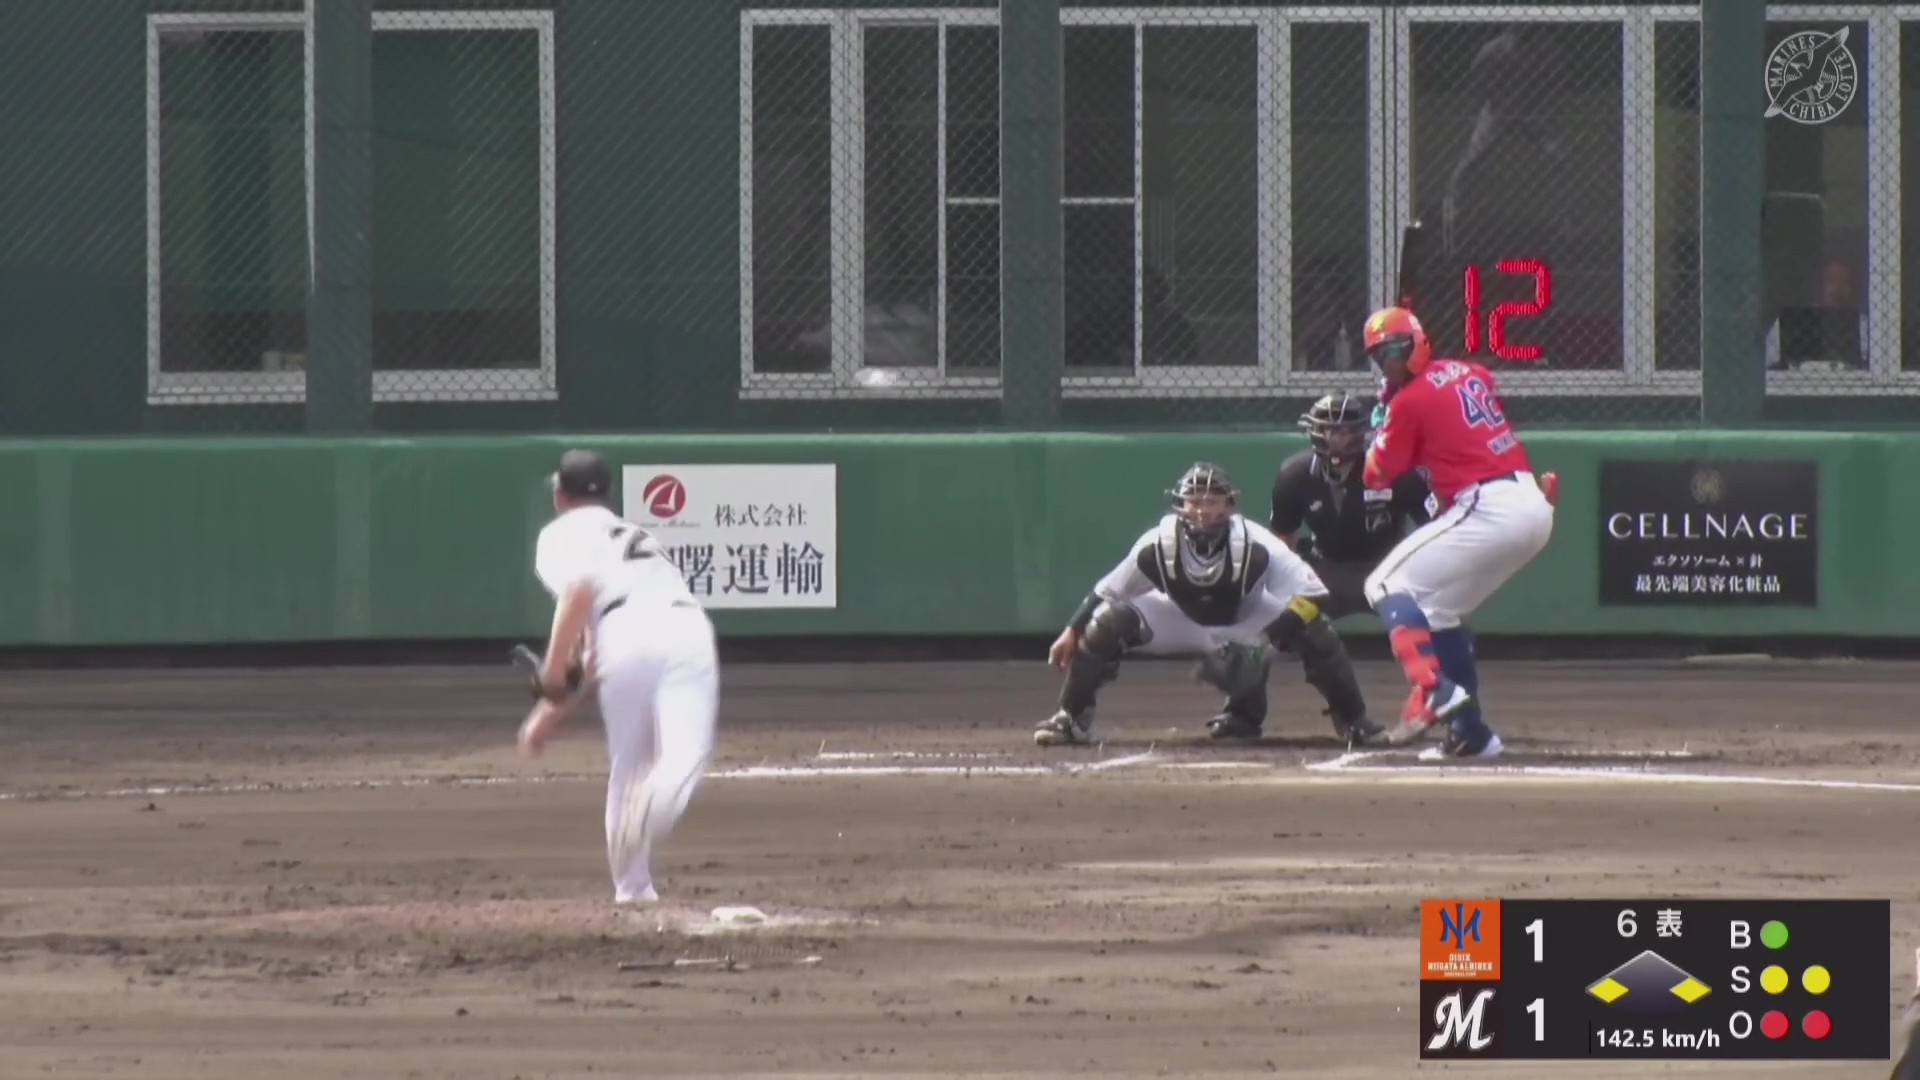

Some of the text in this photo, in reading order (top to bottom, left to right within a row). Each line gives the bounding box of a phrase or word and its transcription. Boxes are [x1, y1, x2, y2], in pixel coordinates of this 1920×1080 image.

[1465, 259, 1551, 358] 12
[1455, 376, 1505, 430] 42
[714, 503, 807, 528] 株式会社
[1608, 512, 1808, 539] CELLNAGE
[1652, 553, 1731, 568] エクソソーム
[1749, 552, 1764, 569] 針
[1635, 574, 1781, 593] 最先端美容化粧品
